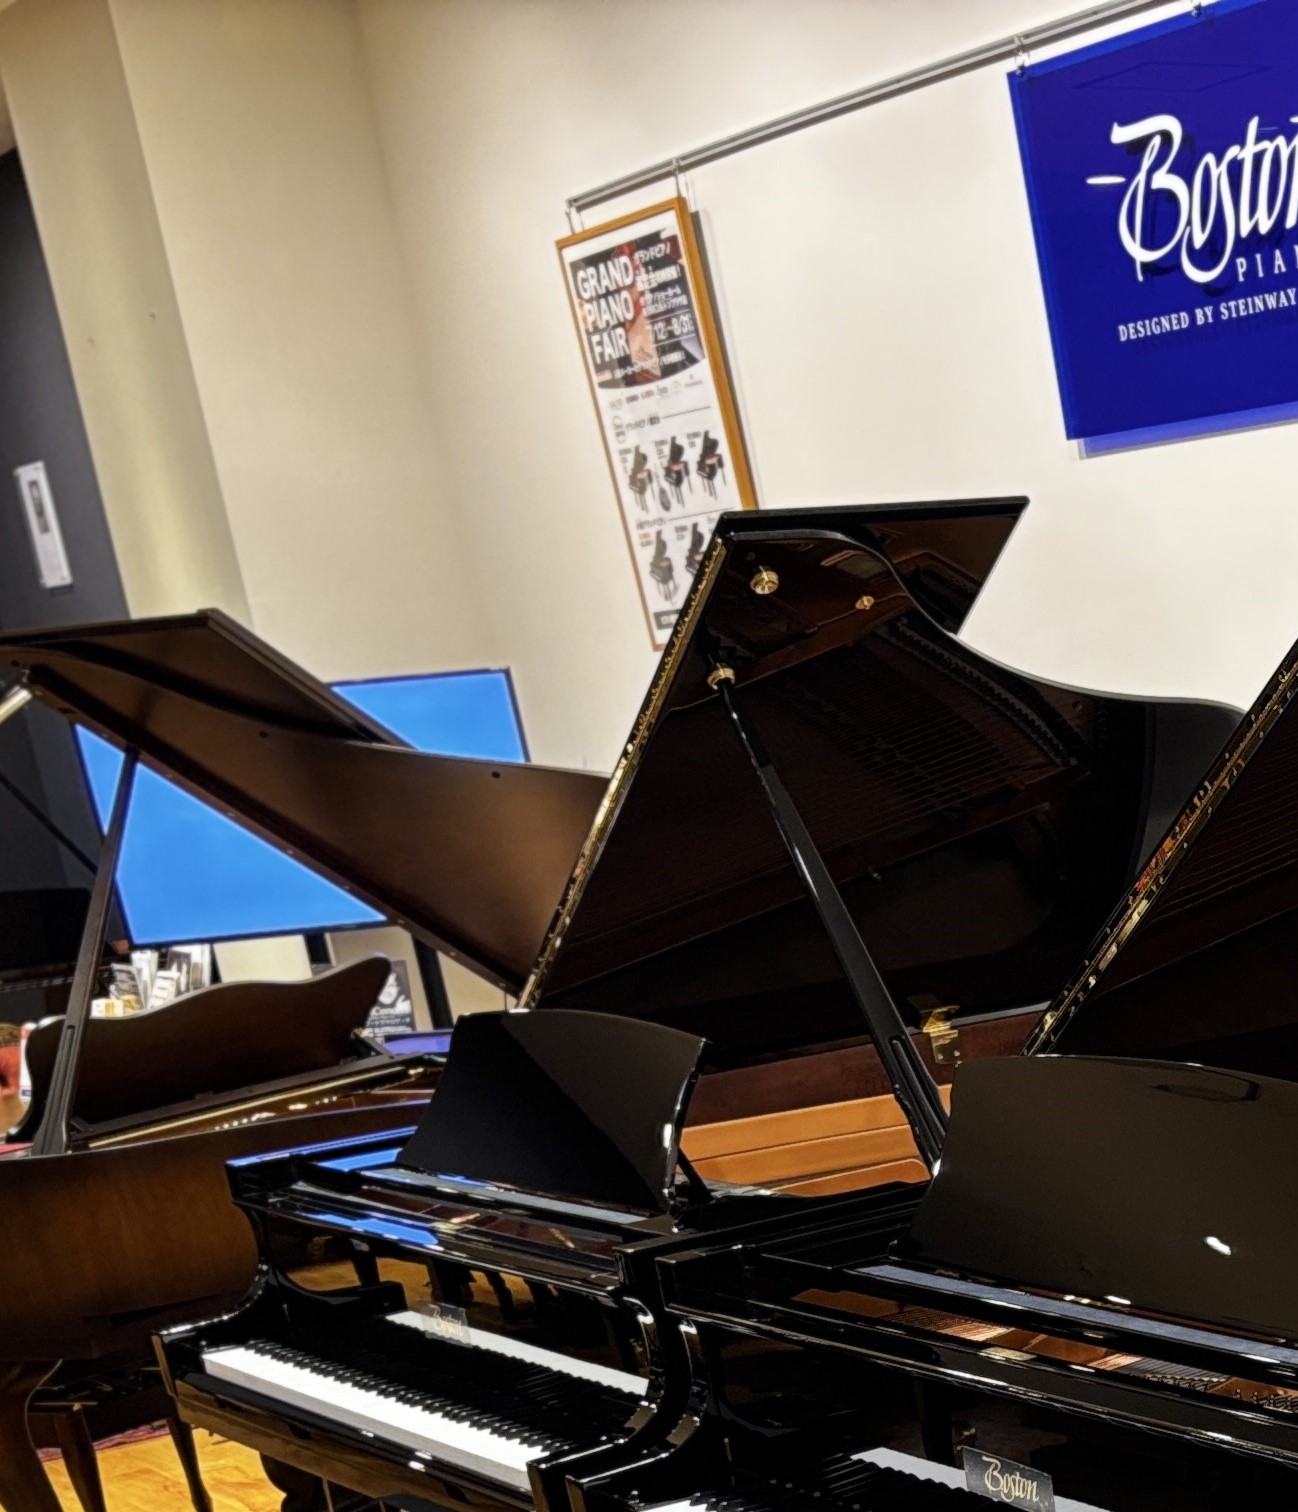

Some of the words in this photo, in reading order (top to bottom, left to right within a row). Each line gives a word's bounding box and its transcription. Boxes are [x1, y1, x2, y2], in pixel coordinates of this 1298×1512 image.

[577, 255, 634, 300] GRAND
[585, 289, 635, 333] PIANO
[1118, 311, 1190, 342] DESIGNED
[1195, 308, 1215, 326] BY
[1220, 287, 1297, 321] STEINWAY
[591, 327, 631, 365] FAIR
[982, 1455, 1039, 1502] Boston
